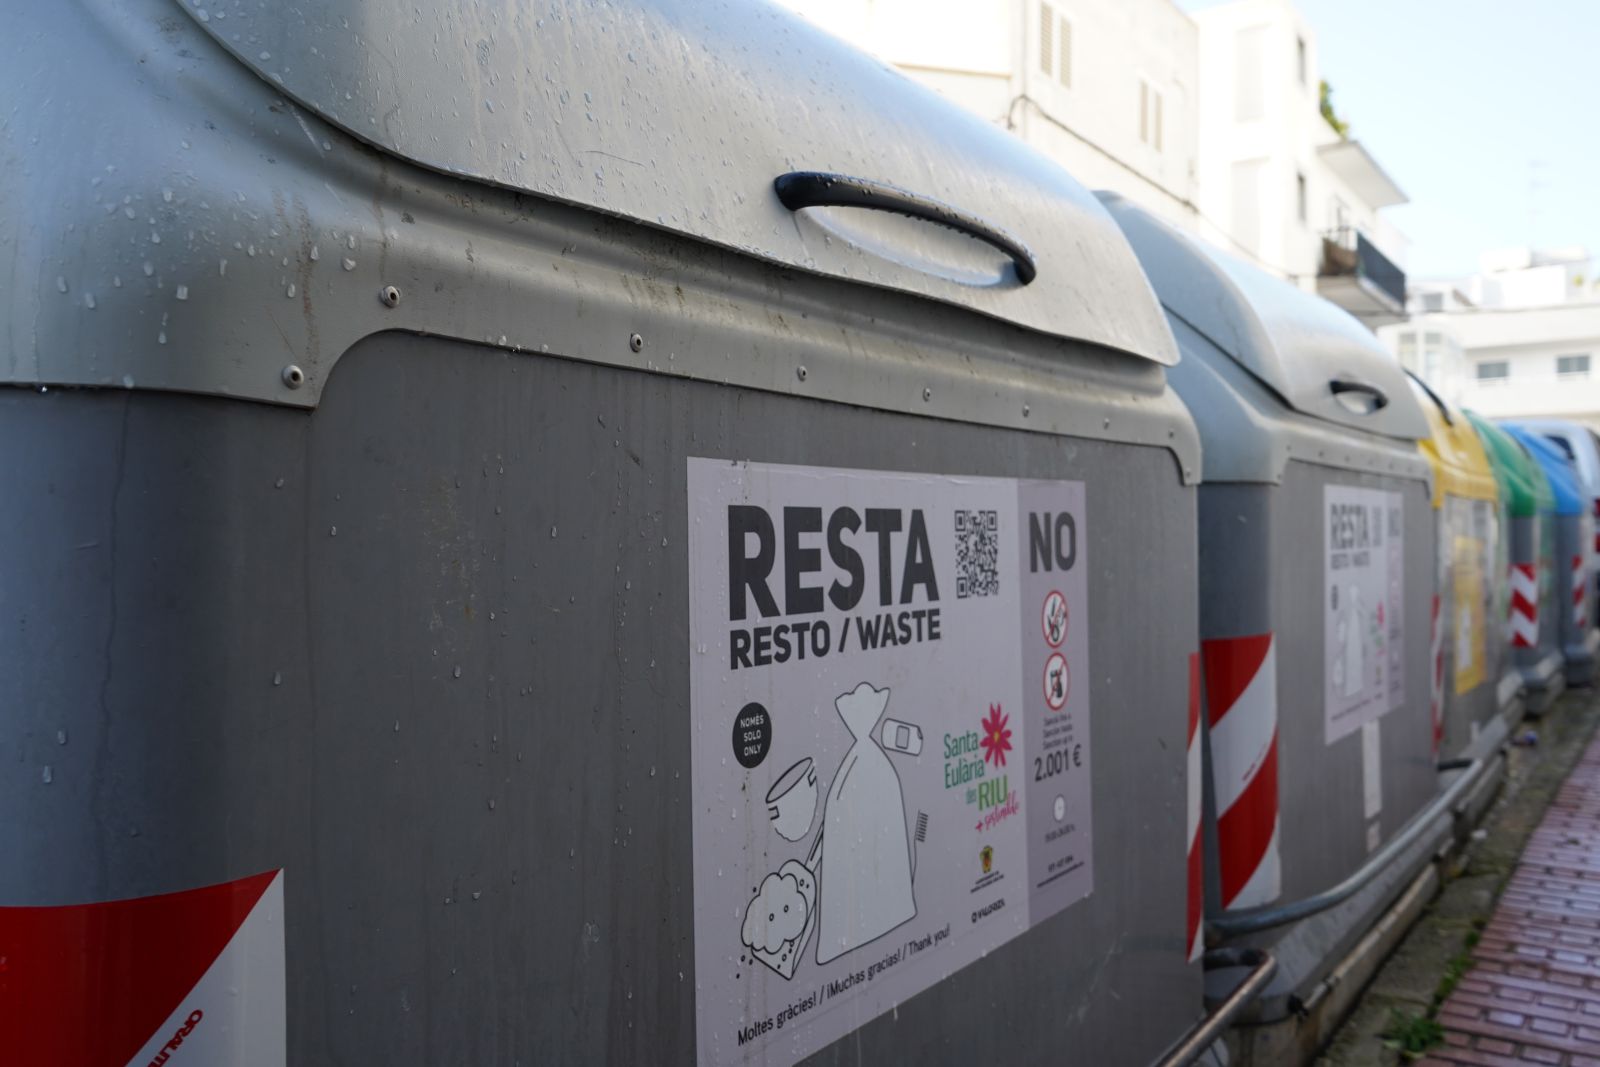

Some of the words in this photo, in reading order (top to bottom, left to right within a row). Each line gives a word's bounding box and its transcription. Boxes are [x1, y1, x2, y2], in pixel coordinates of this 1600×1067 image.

[1029, 511, 1077, 573] NO
[728, 504, 940, 621] RESTA
[729, 619, 831, 671] RESTO
[838, 617, 850, 653] /
[856, 608, 941, 651] WASTE
[743, 729, 761, 742] SOLO
[743, 743, 762, 757] ONLY
[944, 729, 979, 759] Santa
[1034, 748, 1069, 782] 2.001
[978, 774, 1008, 811] RIU
[738, 1018, 773, 1046] Moltes
[908, 933, 932, 955] Thank
